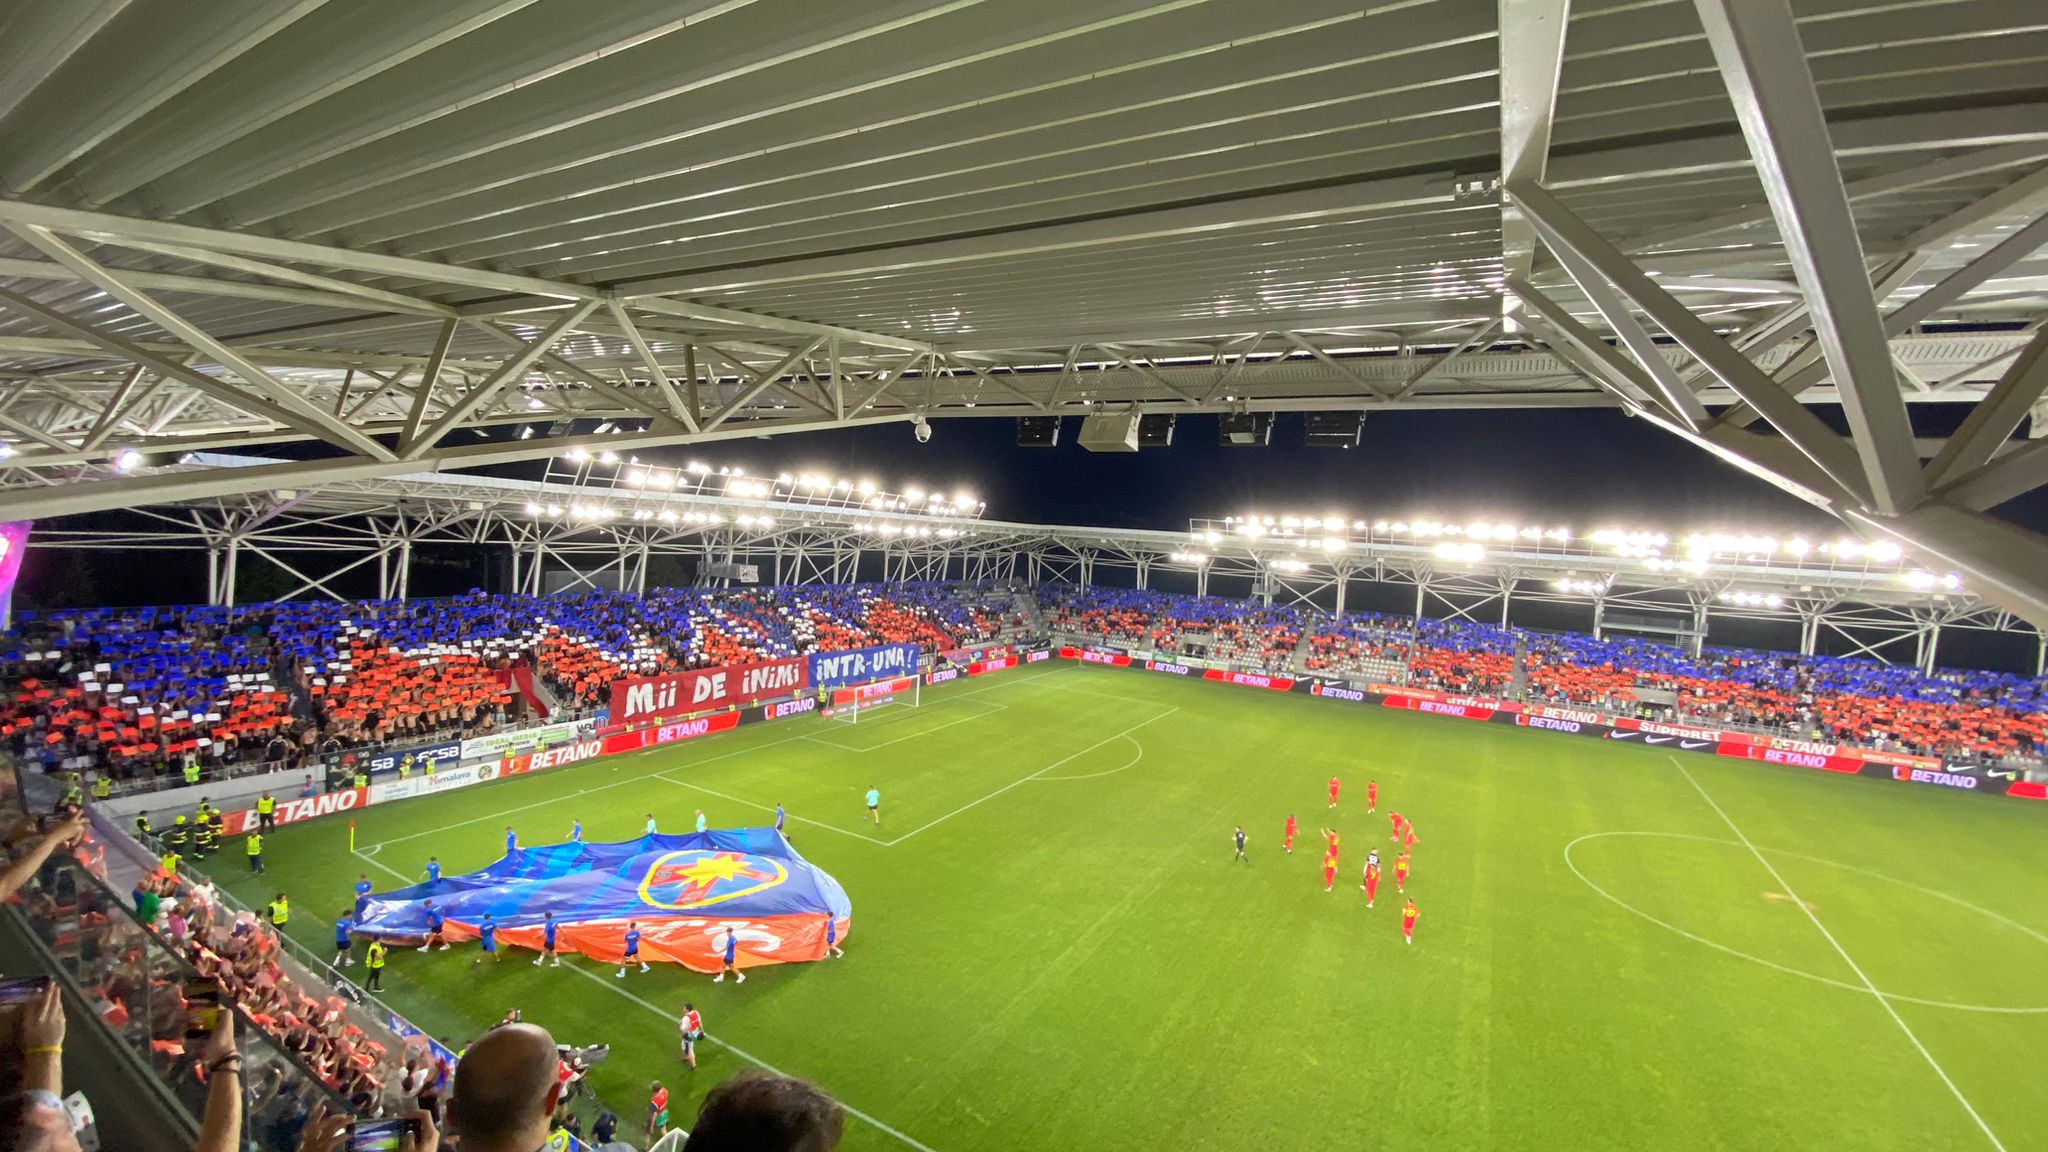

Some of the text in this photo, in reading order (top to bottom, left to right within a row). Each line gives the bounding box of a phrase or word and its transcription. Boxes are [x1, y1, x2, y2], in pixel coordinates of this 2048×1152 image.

[1154, 663, 1188, 675] BETANO
[692, 672, 726, 704] DE
[1233, 673, 1270, 687] BETANO
[1321, 687, 1363, 700] BETANO
[776, 698, 815, 716] BETANO
[1419, 701, 1465, 716] BETANO
[1542, 707, 1597, 724] BETANO
[658, 720, 708, 741] BETANO
[1528, 717, 1580, 733] BETANO
[529, 741, 602, 770] BETANO
[1771, 738, 1836, 756] BETANO
[1764, 750, 1827, 768] BETANO
[1910, 769, 1977, 788] BETANO
[242, 790, 357, 832] BETANO
